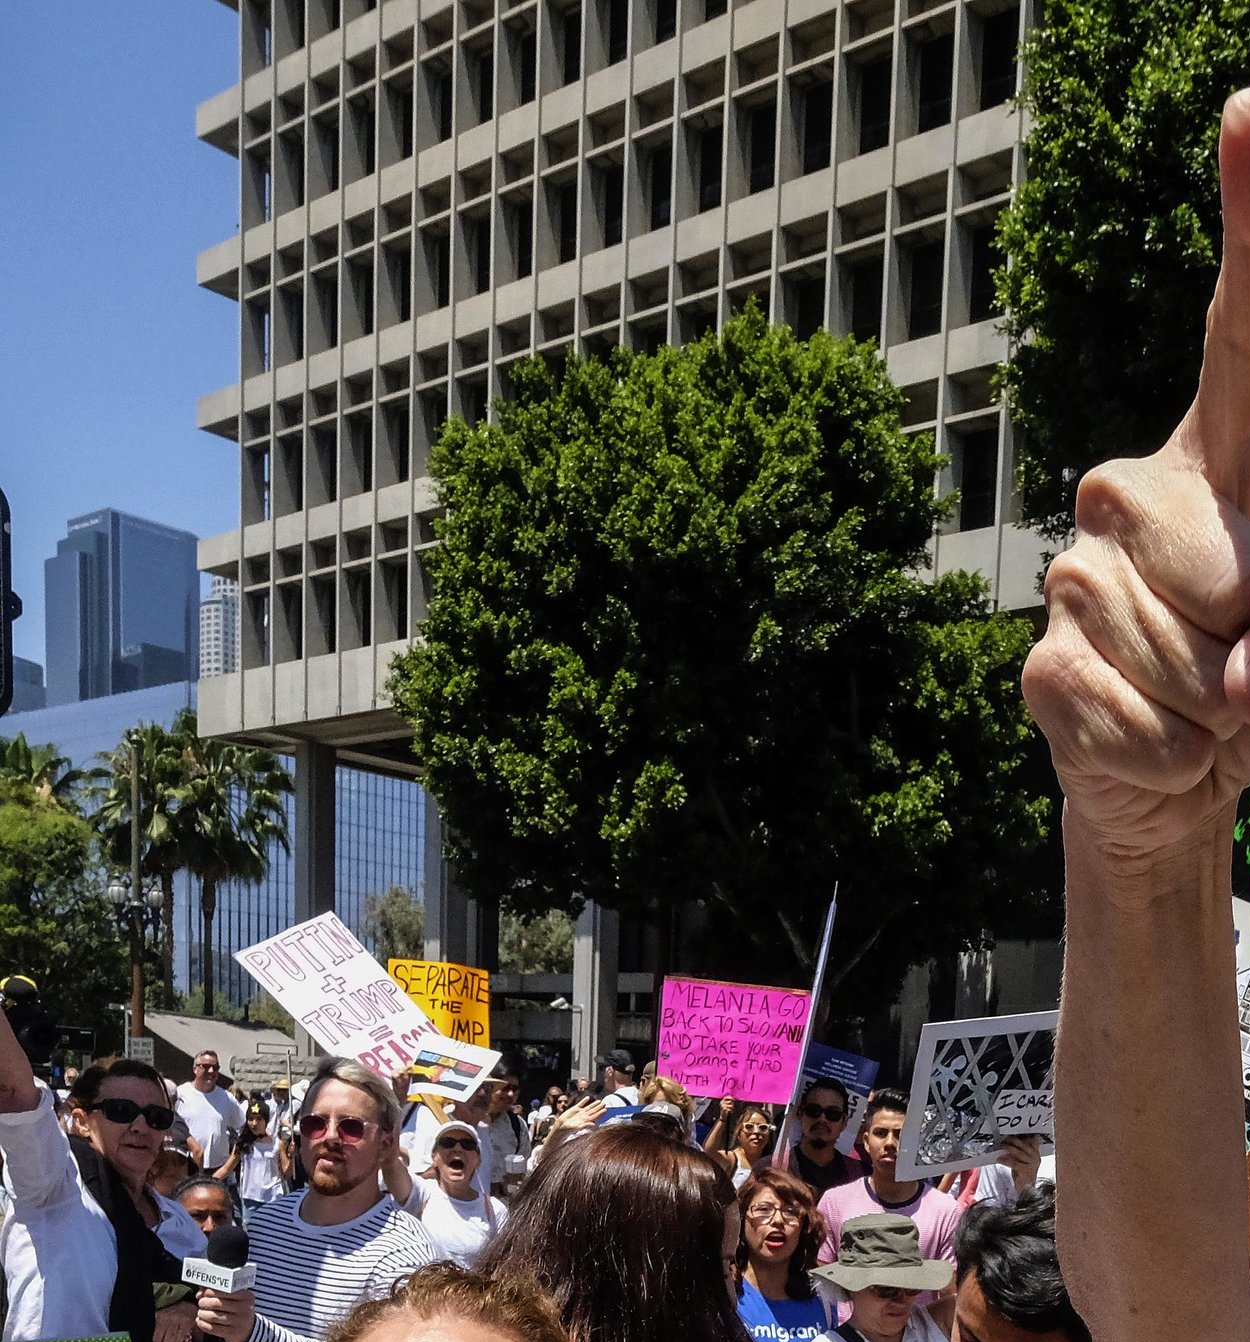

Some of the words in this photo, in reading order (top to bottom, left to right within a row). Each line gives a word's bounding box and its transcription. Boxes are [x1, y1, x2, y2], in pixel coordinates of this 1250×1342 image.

[244, 917, 364, 993] PUTIN
[393, 964, 489, 1004] SEPARATE
[301, 979, 405, 1046] TRUMP
[429, 998, 463, 1014] THE
[670, 982, 771, 1018] MELANIA
[777, 994, 806, 1020] GO
[662, 1008, 711, 1033] BACK
[715, 1015, 734, 1033] TO
[661, 1031, 692, 1050] AND
[694, 1034, 740, 1055] TAKE
[747, 1041, 782, 1059] YOUR
[684, 1052, 739, 1077] Orange
[746, 1058, 783, 1073] TURD
[670, 1070, 710, 1086] WITH
[996, 1115, 1023, 1128] DO
